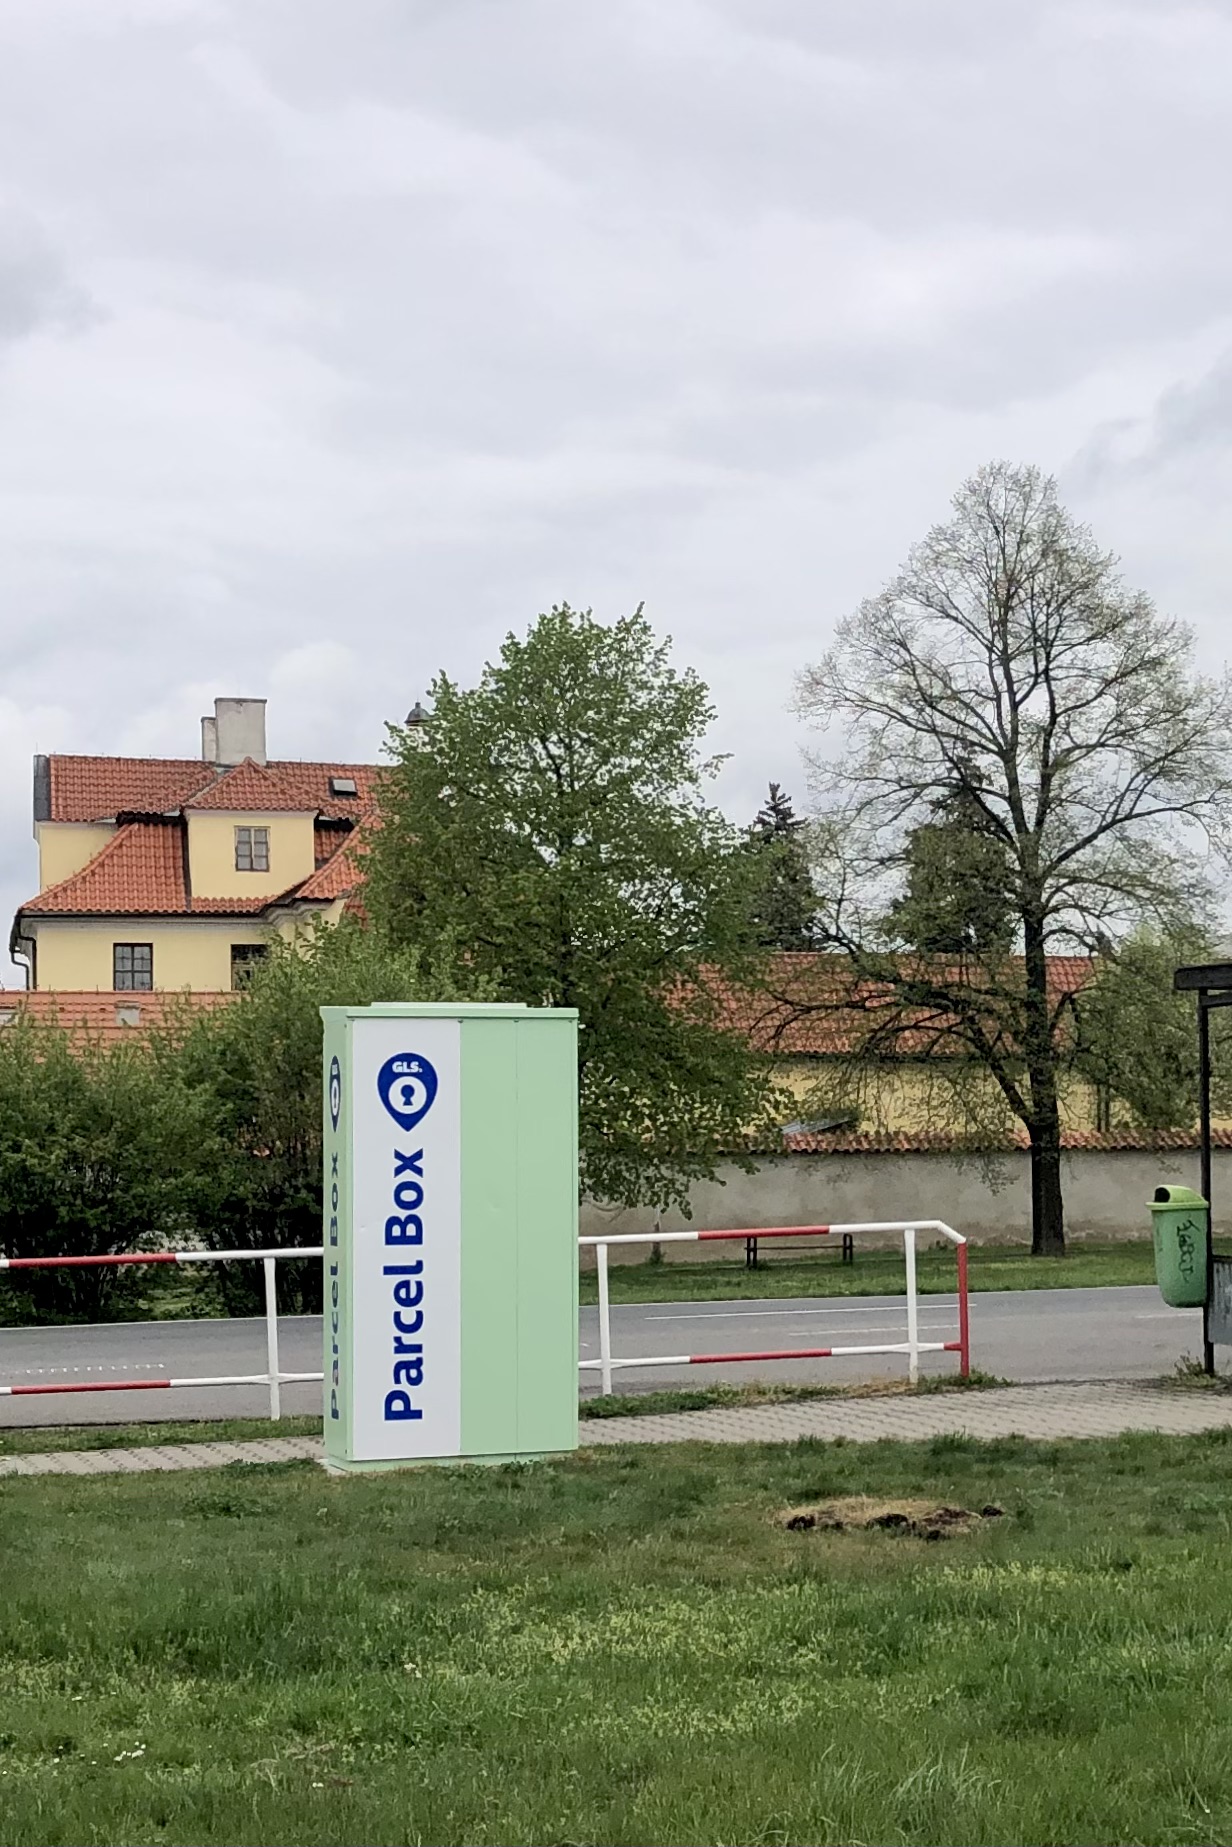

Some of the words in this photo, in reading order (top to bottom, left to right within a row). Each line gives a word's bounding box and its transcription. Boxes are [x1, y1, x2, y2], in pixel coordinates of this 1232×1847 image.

[330, 1152, 339, 1247] Box
[384, 1148, 424, 1246] Box
[330, 1261, 339, 1421] Parcel
[383, 1260, 424, 1421] Parcel
